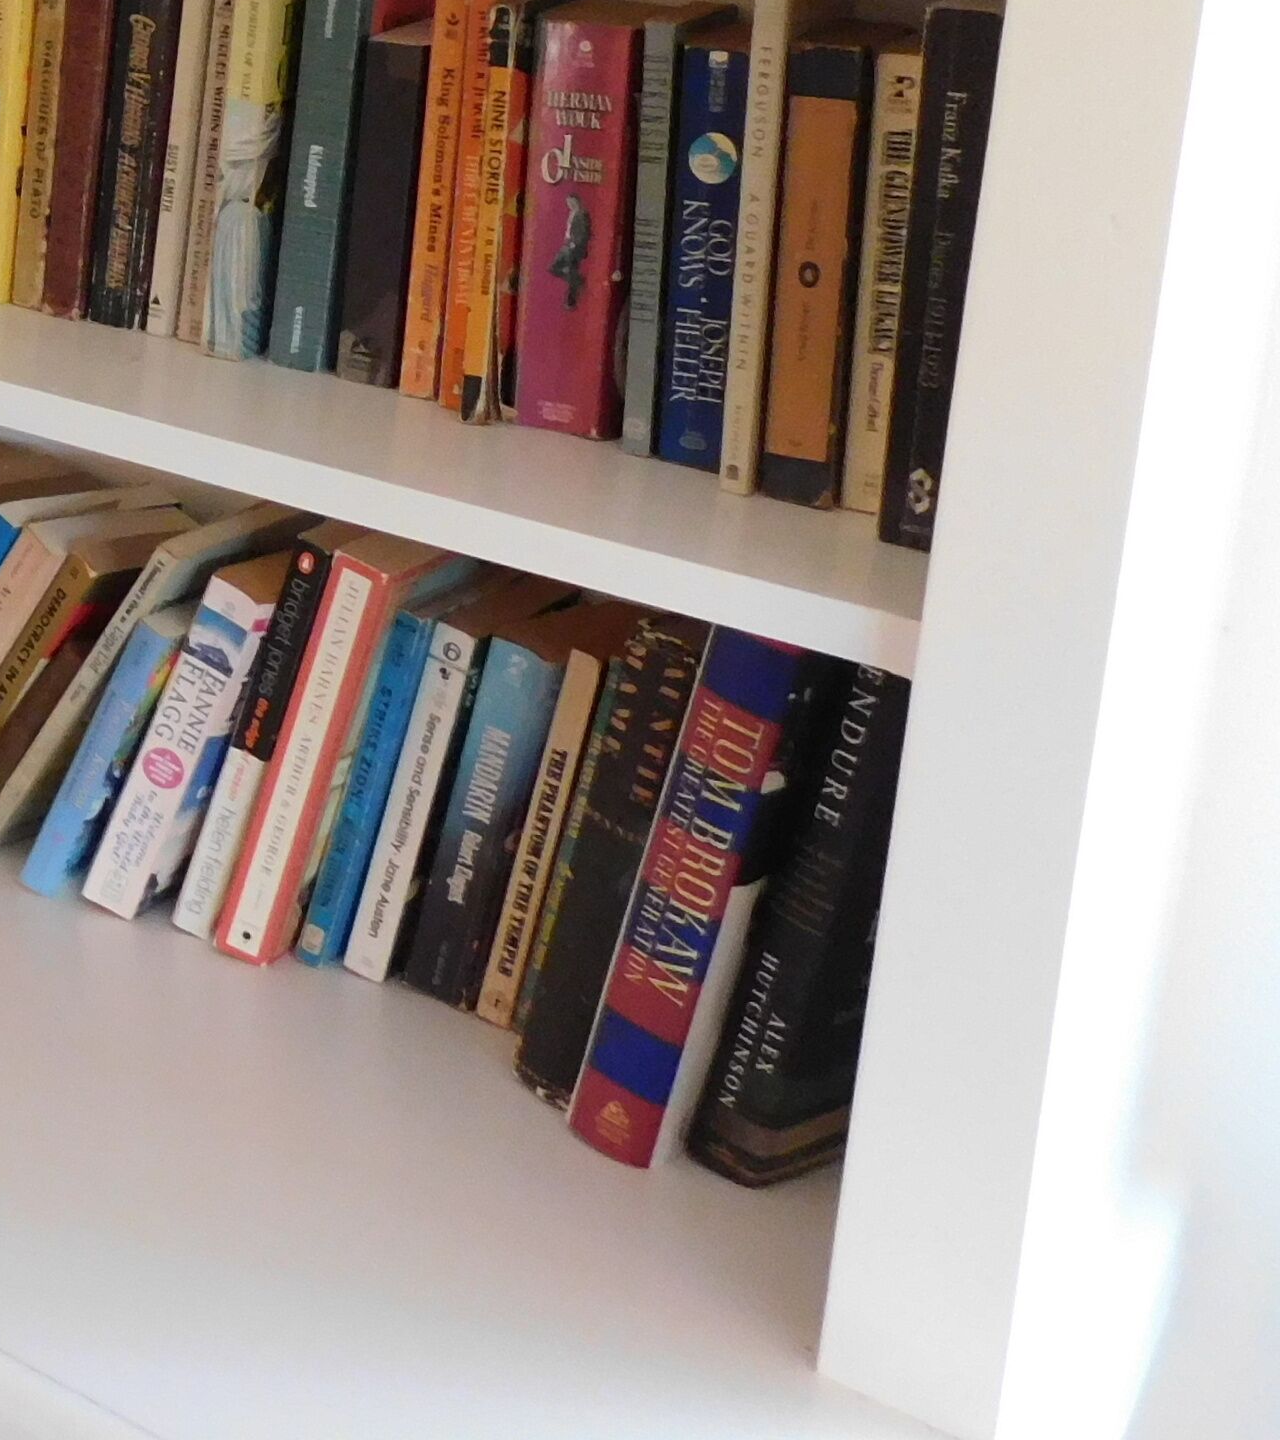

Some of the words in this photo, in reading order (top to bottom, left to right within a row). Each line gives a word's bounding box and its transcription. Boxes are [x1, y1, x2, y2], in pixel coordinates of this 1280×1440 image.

[440, 66, 458, 108] King
[167, 143, 180, 173] SUSY
[303, 144, 325, 209] Kidnapped
[432, 112, 453, 202] Solomon's
[159, 174, 176, 214] SMITH
[425, 201, 444, 254] Mines
[677, 198, 711, 290] KNOWS
[707, 218, 734, 278] GOD
[668, 306, 703, 403] HELLER
[697, 316, 729, 404] JOSEPH
[19, 587, 68, 665] DEMOCRACY
[4, 664, 20, 686] IN
[153, 658, 197, 741] FLAGG
[187, 670, 228, 755] FANNIE
[421, 711, 442, 753] Sense
[689, 698, 724, 751] THE
[413, 754, 429, 785] and
[550, 749, 569, 777] THE
[710, 717, 766, 812] TOM
[814, 662, 884, 829] ENDURE
[211, 806, 238, 853] helen
[392, 785, 423, 854] Sensibility
[529, 778, 562, 859] PHANTOM
[656, 750, 707, 852] GREATEST
[186, 853, 222, 916] fielding
[381, 858, 402, 892] Jane
[514, 878, 536, 911] THE
[523, 858, 541, 879] OF
[367, 892, 390, 940] Austen
[497, 912, 527, 979] TEMPLE
[623, 852, 678, 986] GENERATION
[647, 821, 738, 1008] BROKAW
[717, 950, 781, 1111] HUTCHINSON
[753, 1011, 790, 1076] ALEX
